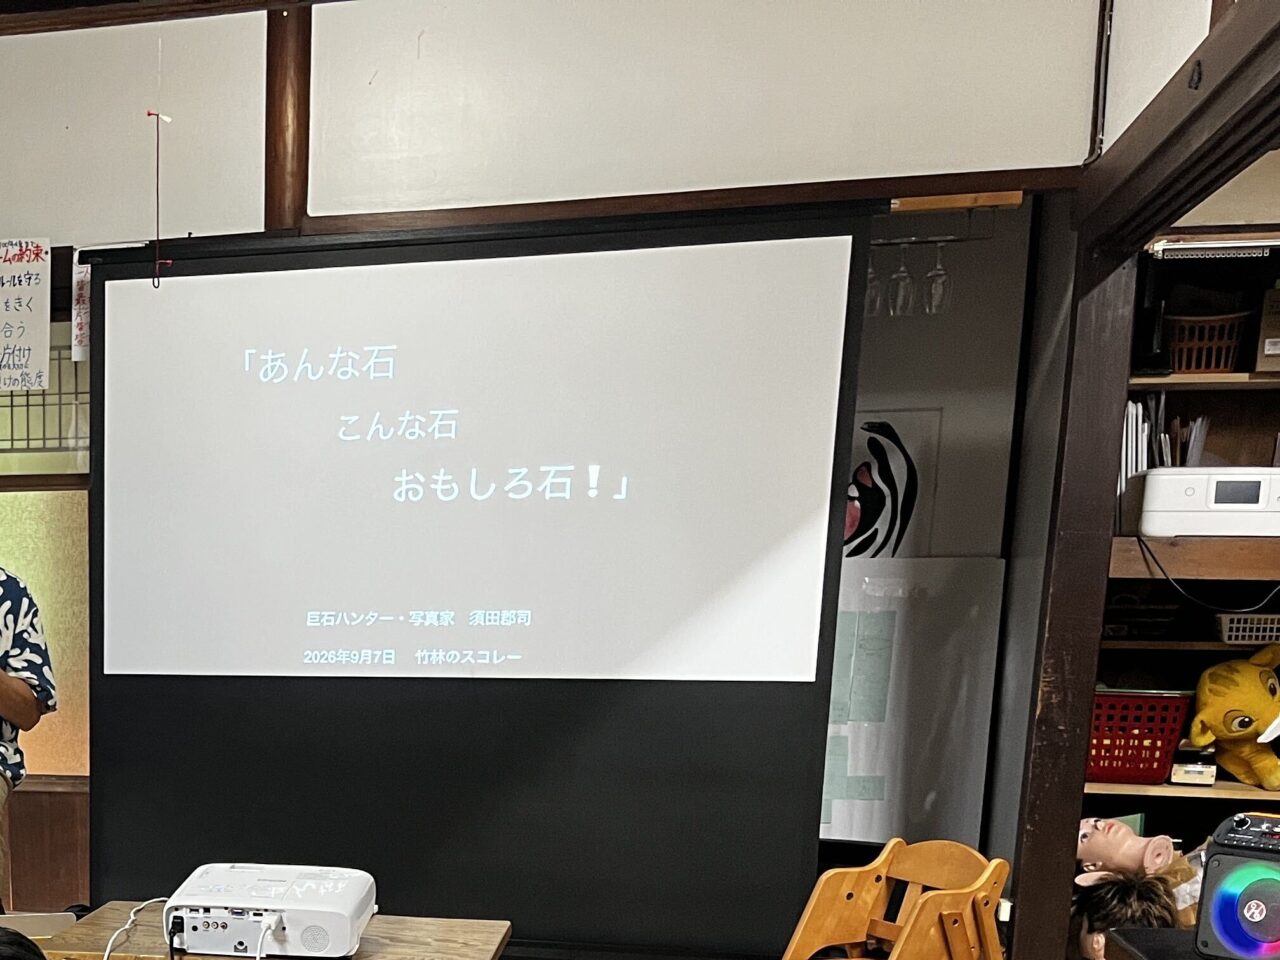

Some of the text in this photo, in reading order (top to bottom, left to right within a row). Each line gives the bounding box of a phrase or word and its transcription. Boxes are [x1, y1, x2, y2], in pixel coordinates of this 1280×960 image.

[243, 344, 398, 383] 「あんな石
[337, 409, 459, 441] こんな石
[306, 610, 532, 627] 巨石ハンター・写真家 須田郡司
[303, 649, 522, 665] 2026年9月7日 竹林のスコレー
